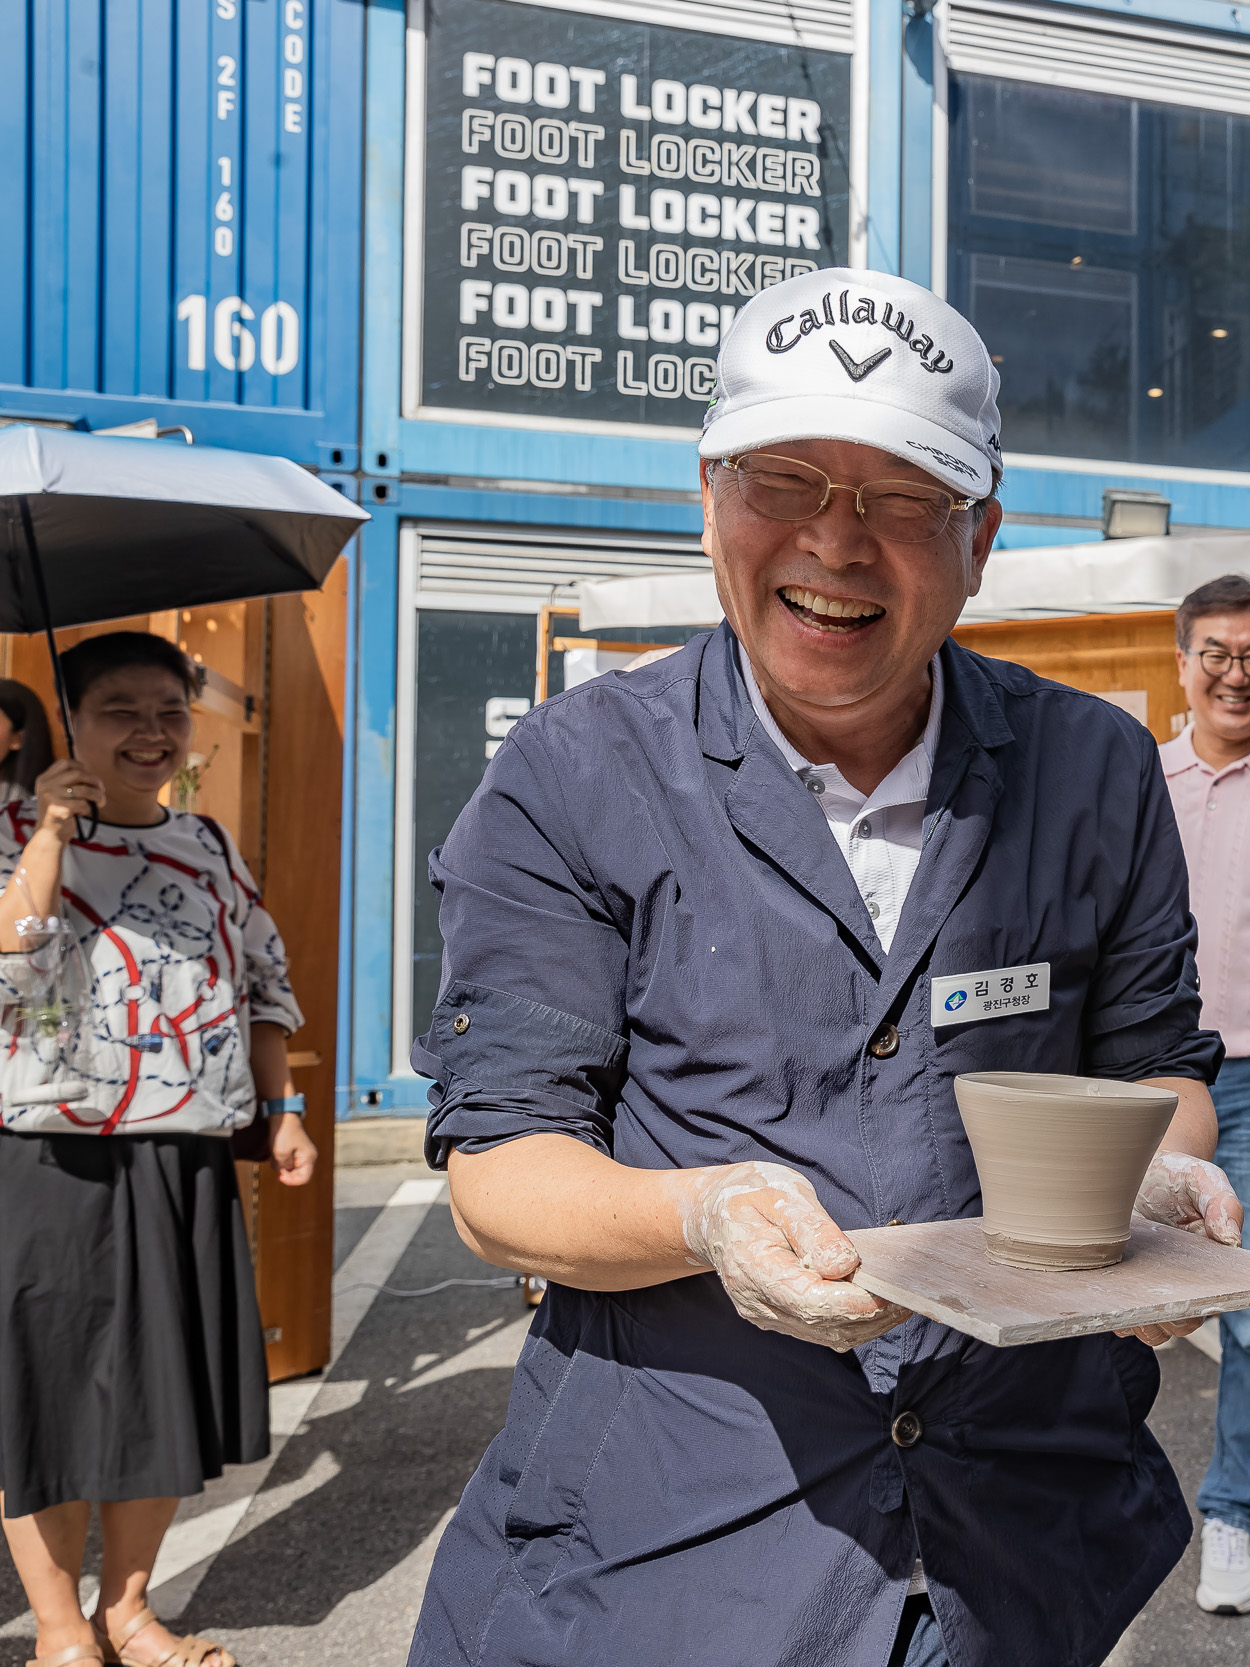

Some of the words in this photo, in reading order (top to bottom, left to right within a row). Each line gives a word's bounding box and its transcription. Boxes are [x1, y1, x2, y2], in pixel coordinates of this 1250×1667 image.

[217, 55, 236, 120] 2F
[284, 0, 303, 133] CODE
[462, 51, 606, 113] FOOT
[620, 73, 822, 144] LOCKER
[461, 107, 605, 169] FOOT
[619, 128, 822, 197] LOCKER
[214, 156, 234, 256] 160
[461, 164, 605, 224] FOOT
[618, 183, 821, 251] LOCKER
[460, 221, 604, 280] FOOT
[177, 294, 299, 376] 160
[459, 278, 603, 336] FOOT
[617, 294, 736, 347] LOC
[766, 289, 954, 374] Callaway
[458, 335, 603, 392] FOOT
[616, 349, 718, 402] LOC
[982, 994, 1031, 1012] 광진구청장
